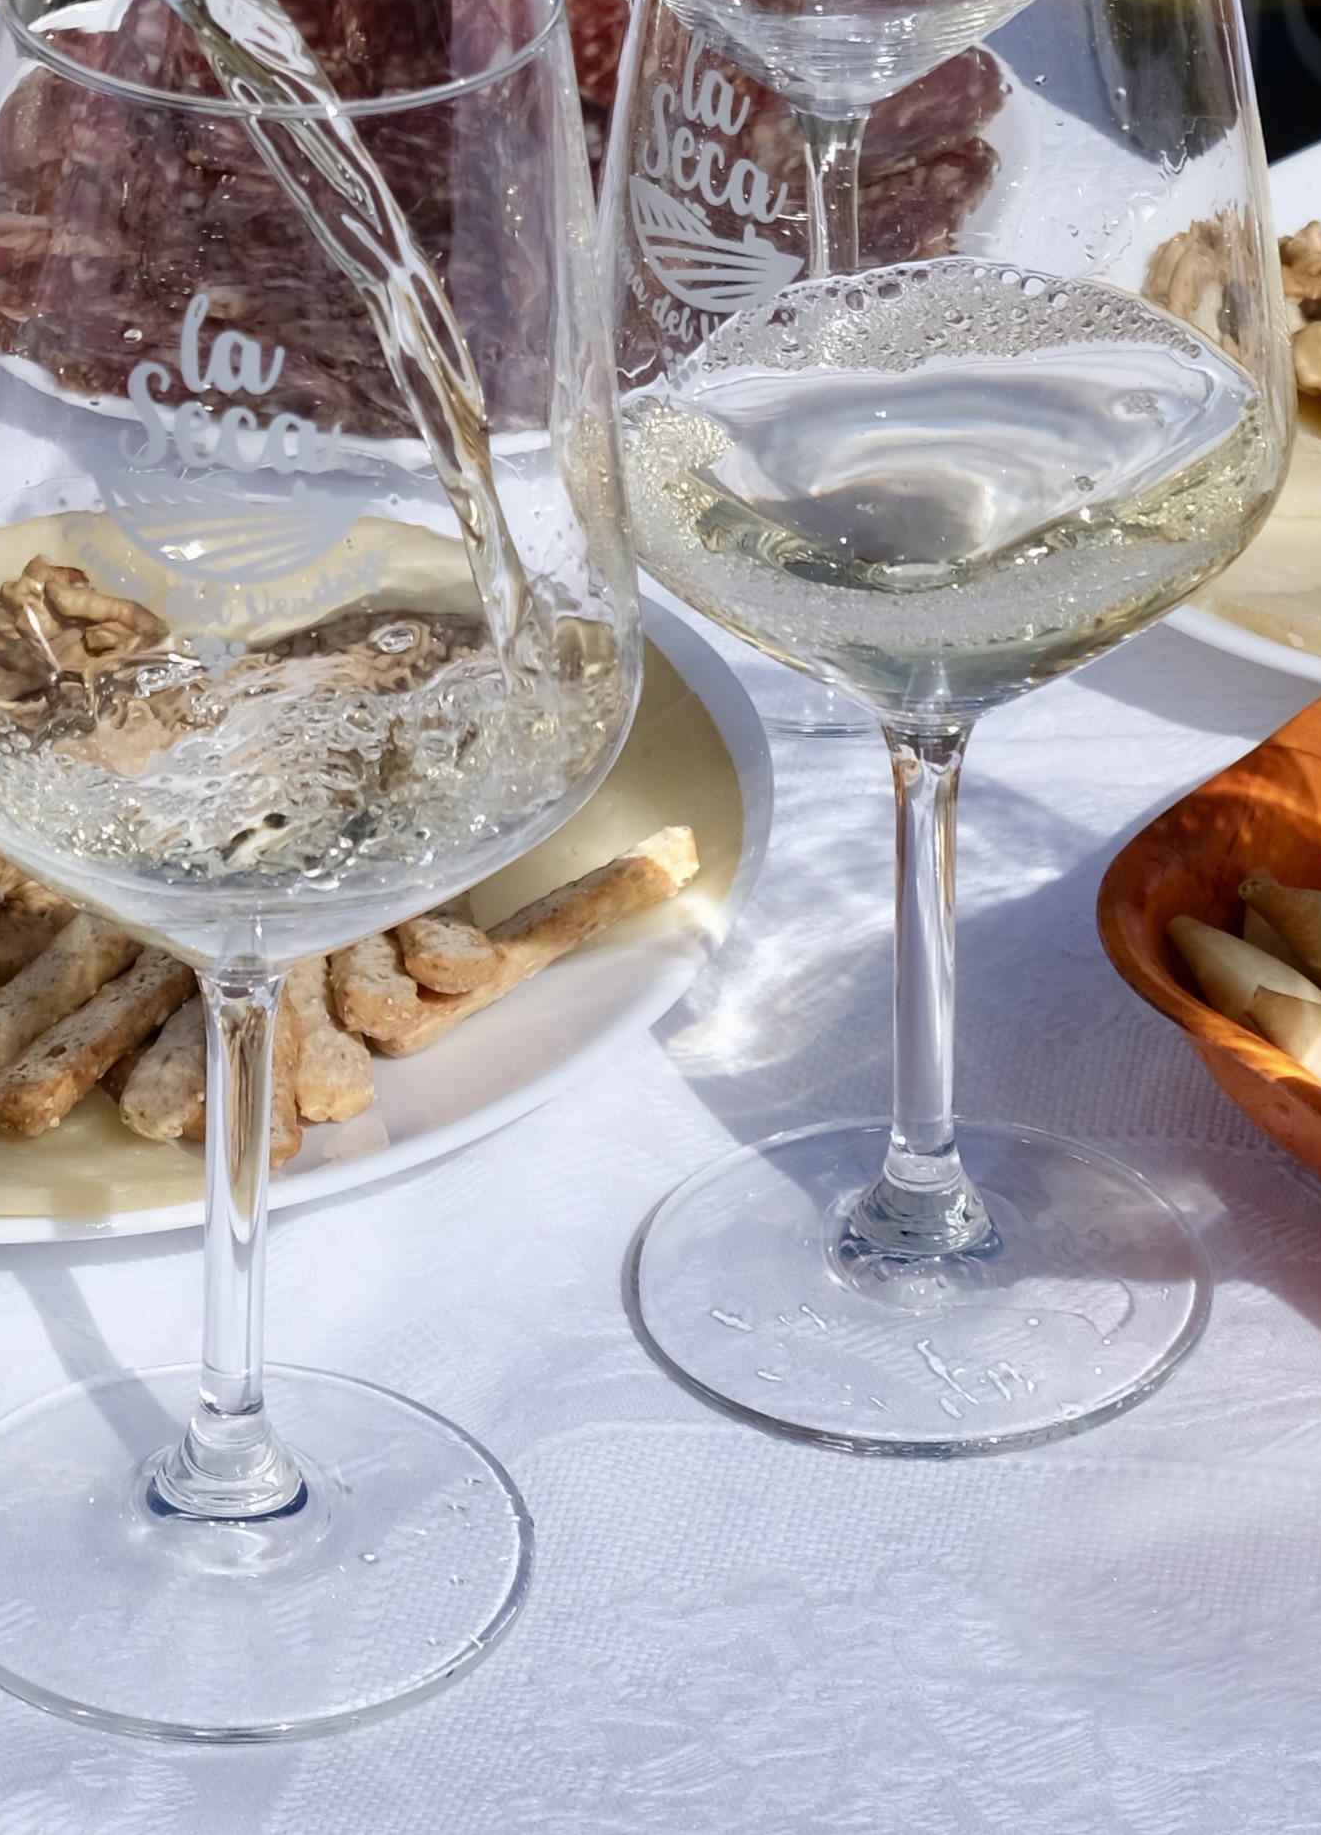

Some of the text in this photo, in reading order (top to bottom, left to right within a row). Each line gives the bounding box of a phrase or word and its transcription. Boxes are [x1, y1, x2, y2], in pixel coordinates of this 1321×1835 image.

[681, 29, 751, 136] la
[642, 82, 788, 224] Seca
[180, 293, 286, 395] la
[651, 294, 694, 344] del
[118, 361, 343, 474] Seca
